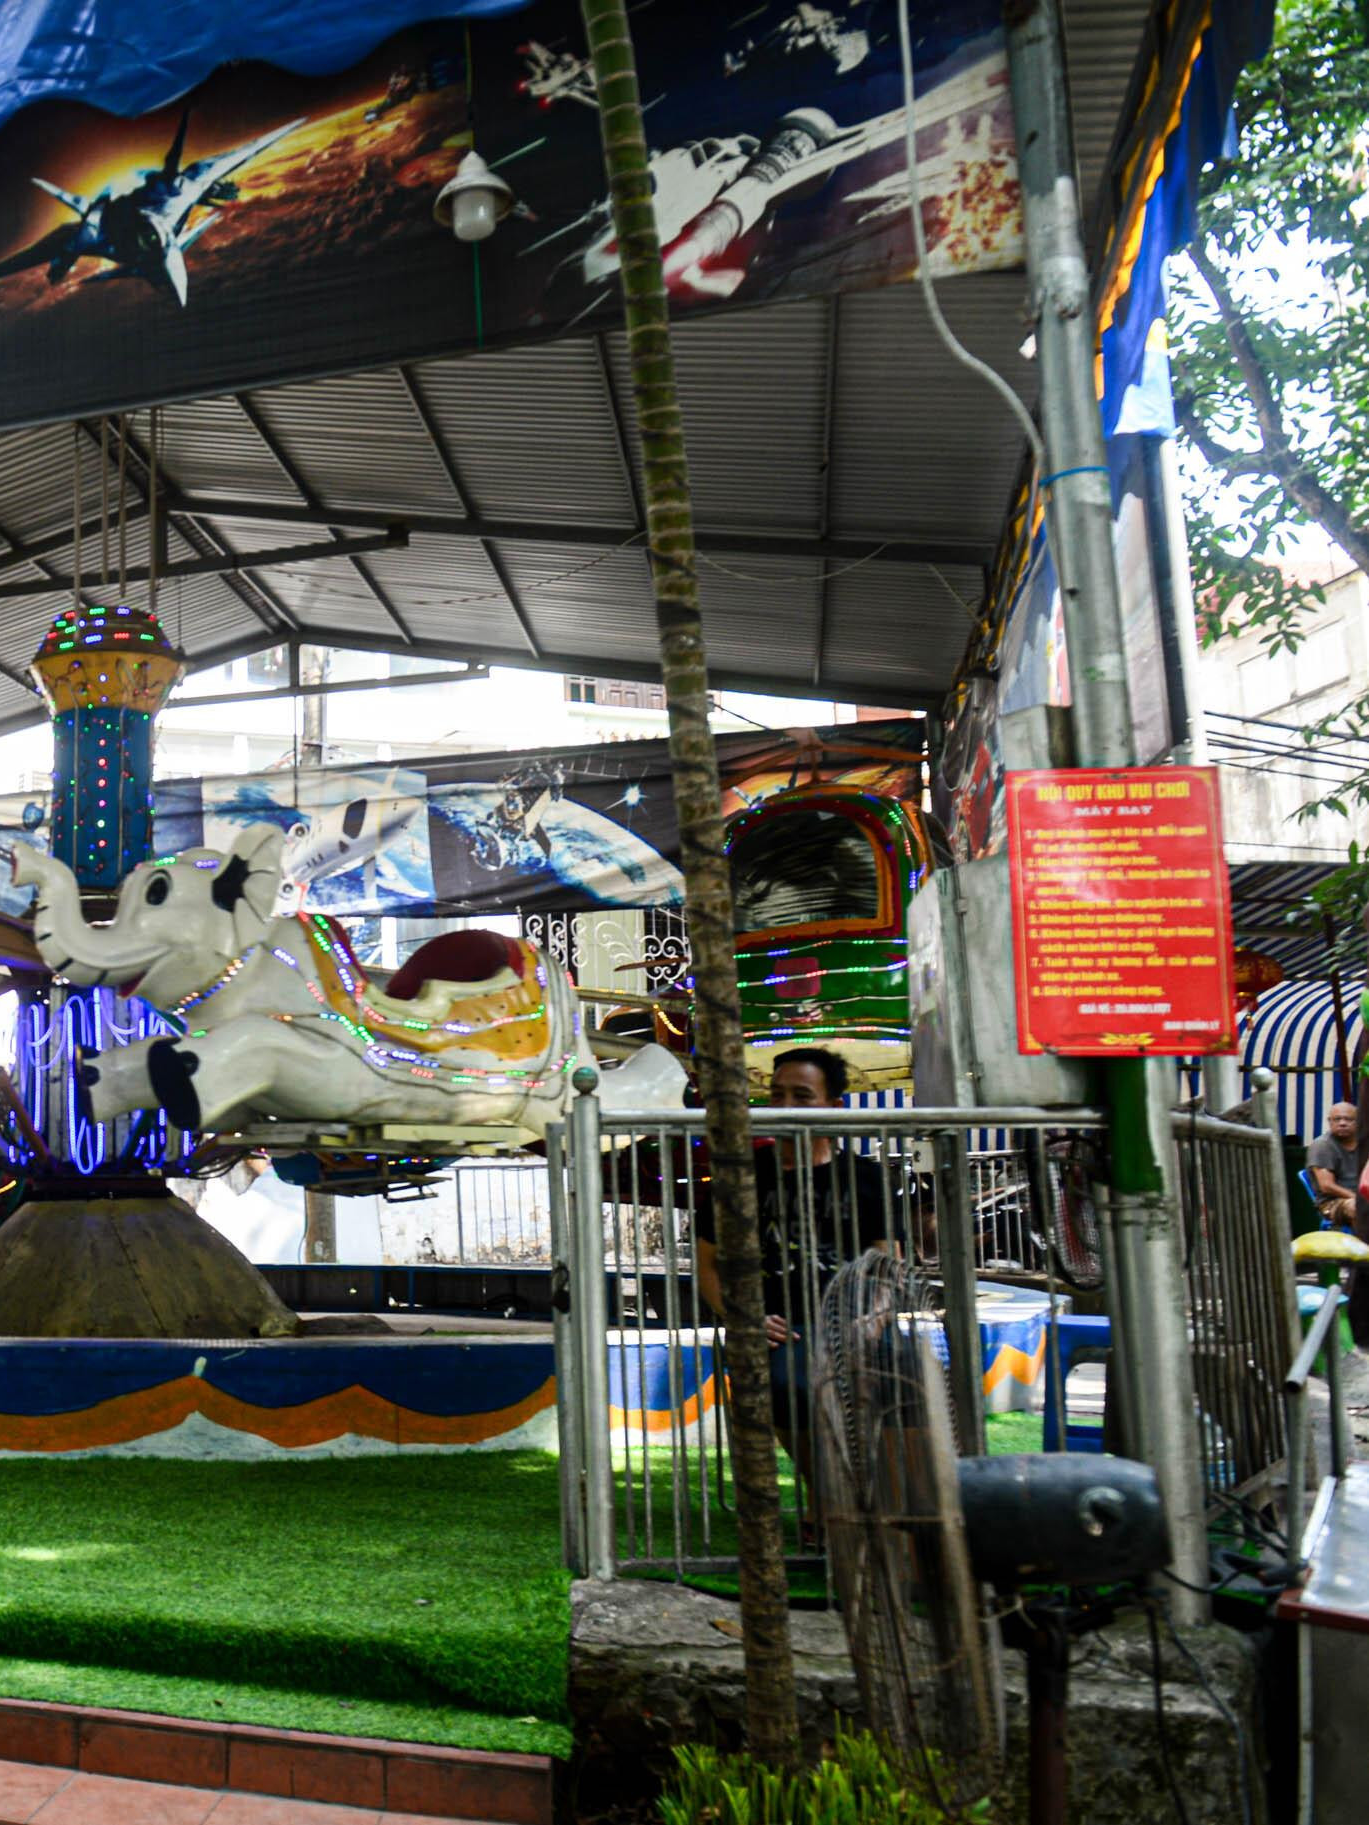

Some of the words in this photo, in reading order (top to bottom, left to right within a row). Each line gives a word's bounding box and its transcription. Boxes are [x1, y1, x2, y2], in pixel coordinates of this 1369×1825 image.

[1065, 784, 1093, 801] QUY
[1096, 784, 1125, 800] KHU
[1128, 783, 1152, 799] VUI
